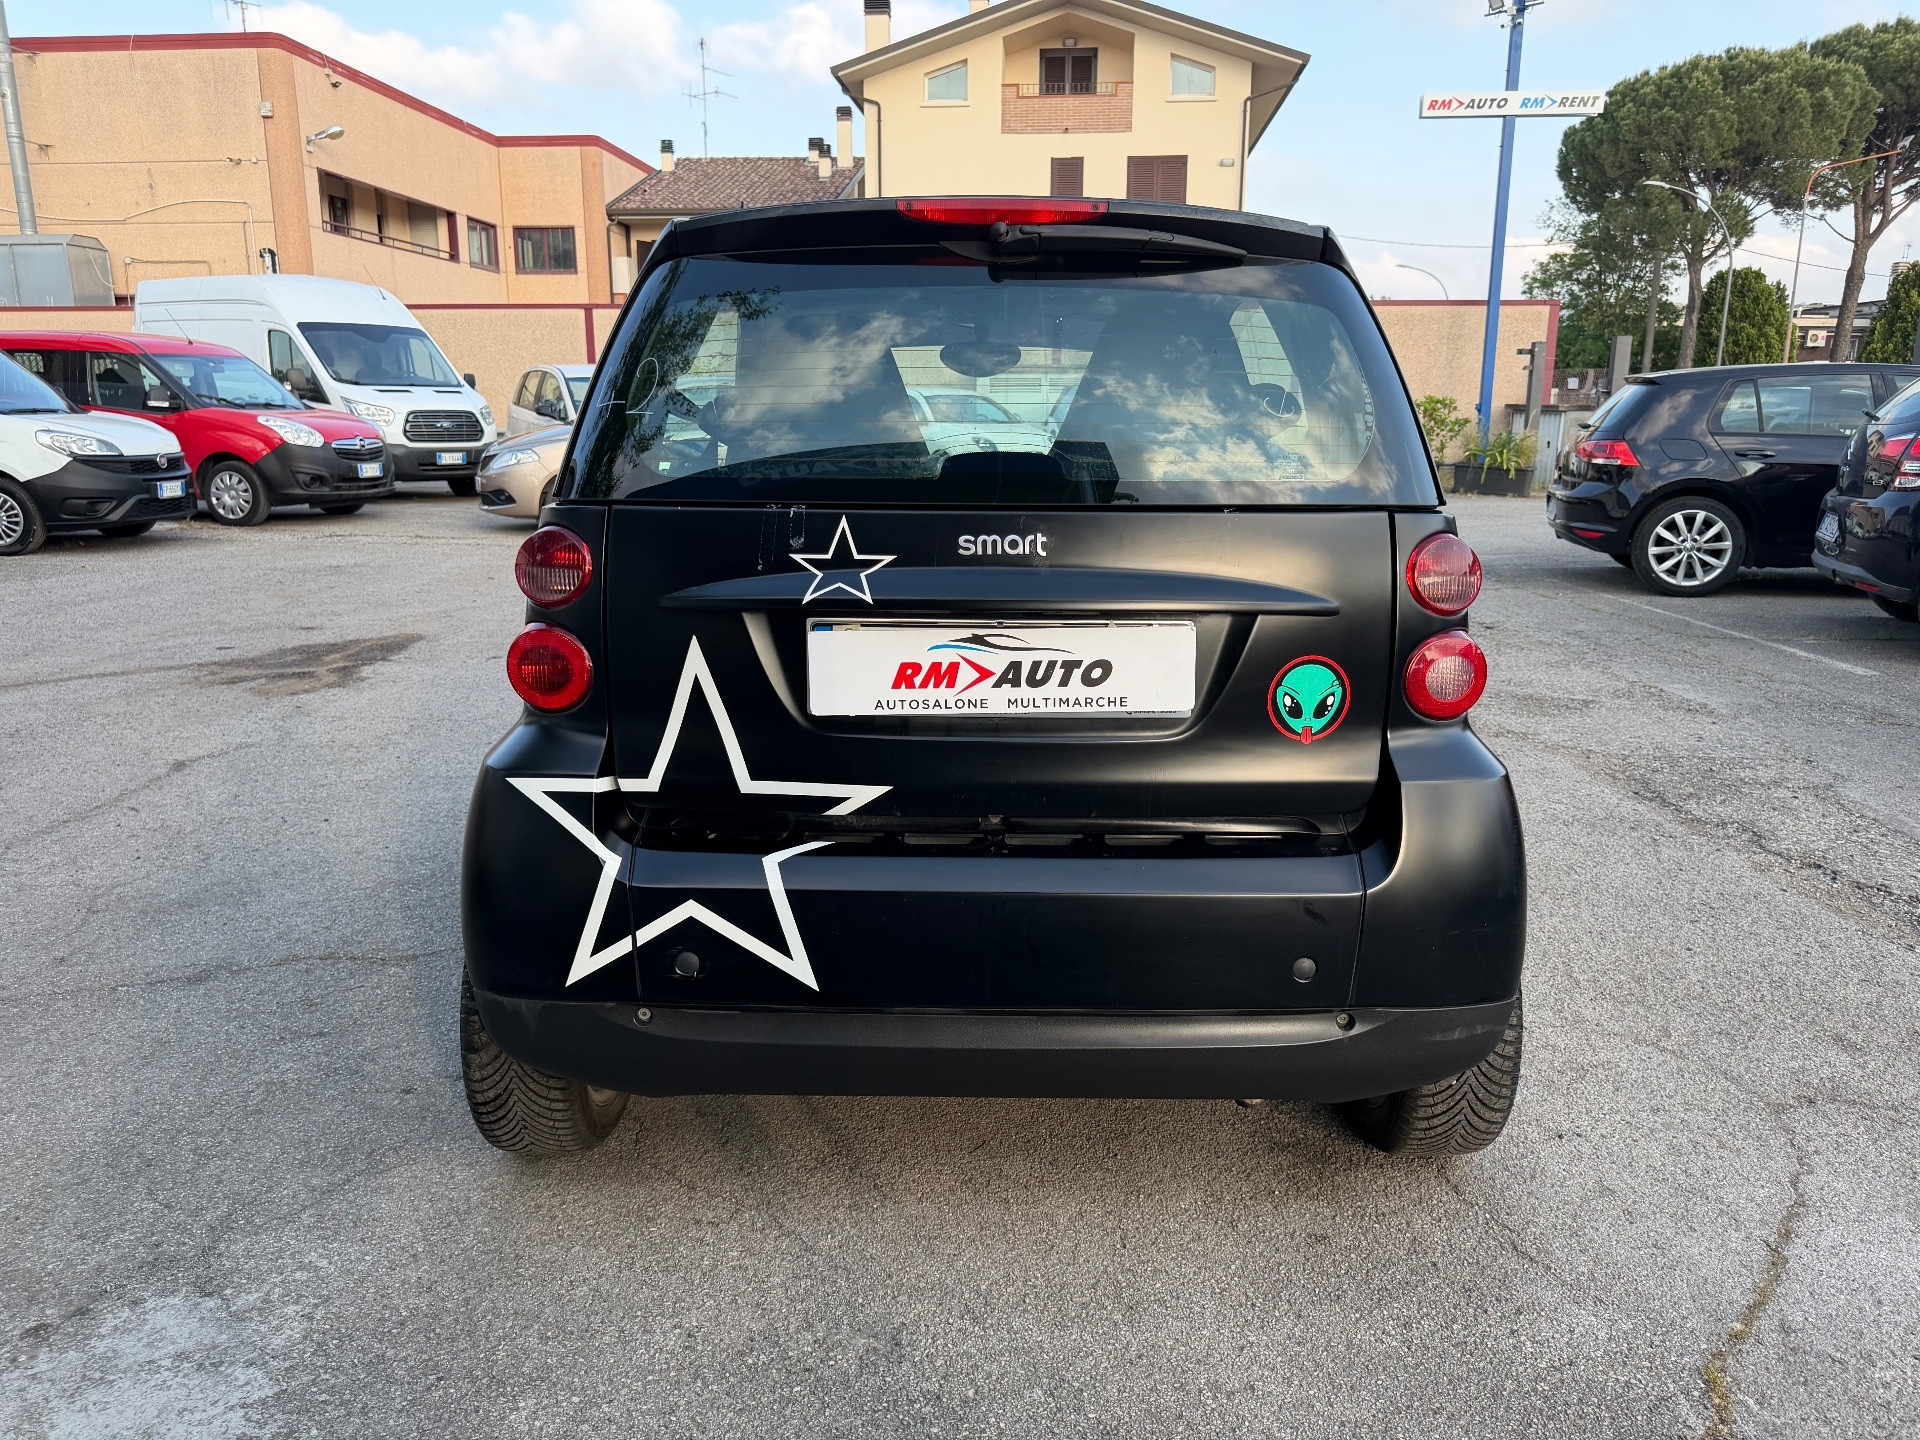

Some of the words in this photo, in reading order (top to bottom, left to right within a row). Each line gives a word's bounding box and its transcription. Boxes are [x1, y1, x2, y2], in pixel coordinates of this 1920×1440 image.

[1427, 98, 1453, 111] RM
[1464, 97, 1509, 110] AUTO
[1557, 95, 1600, 108] RENT
[957, 532, 1047, 556] smart
[890, 661, 961, 690] RM
[990, 658, 1114, 689] AUTO
[873, 698, 989, 711] AUTOSALONE
[1006, 696, 1129, 709] MULTIMARCHE
